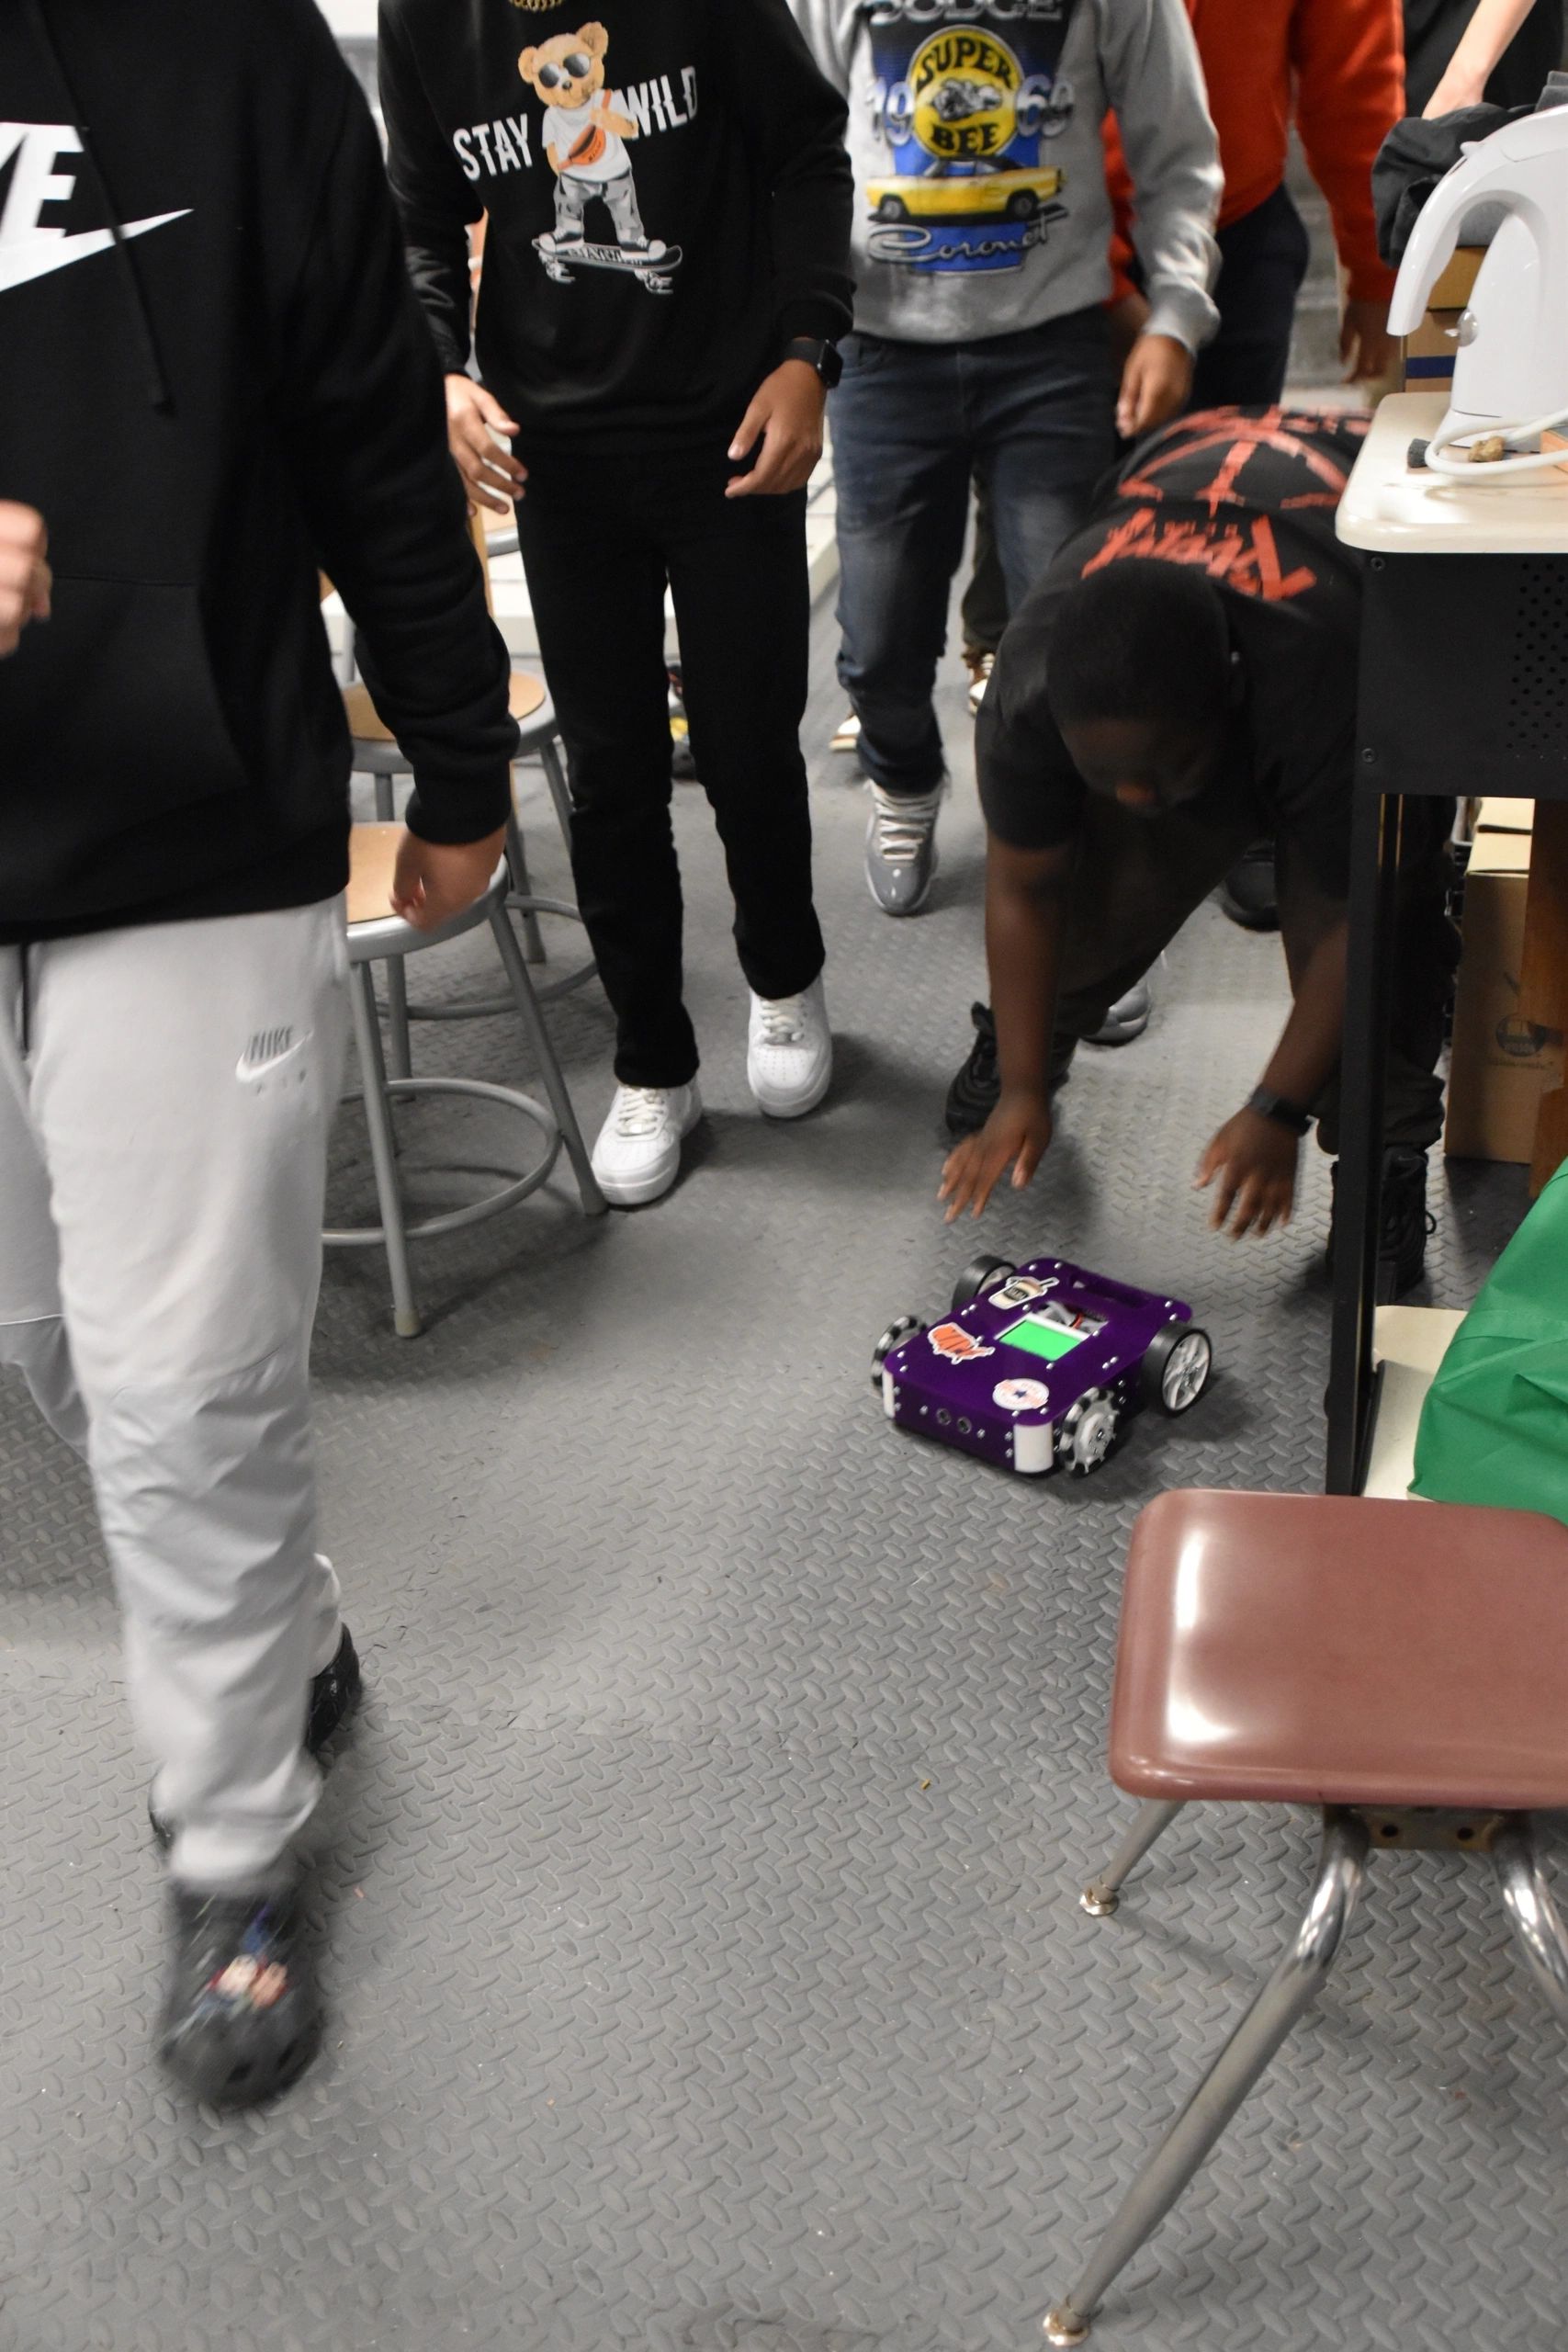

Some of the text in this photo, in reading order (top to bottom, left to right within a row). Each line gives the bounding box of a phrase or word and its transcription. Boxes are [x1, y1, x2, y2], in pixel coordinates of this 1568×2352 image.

[917, 36, 1012, 91] SUPER
[453, 66, 698, 181] STAY WILD
[931, 122, 998, 154] BEE
[868, 212, 1066, 264] Coronet
[246, 1025, 292, 1062] NIKE
